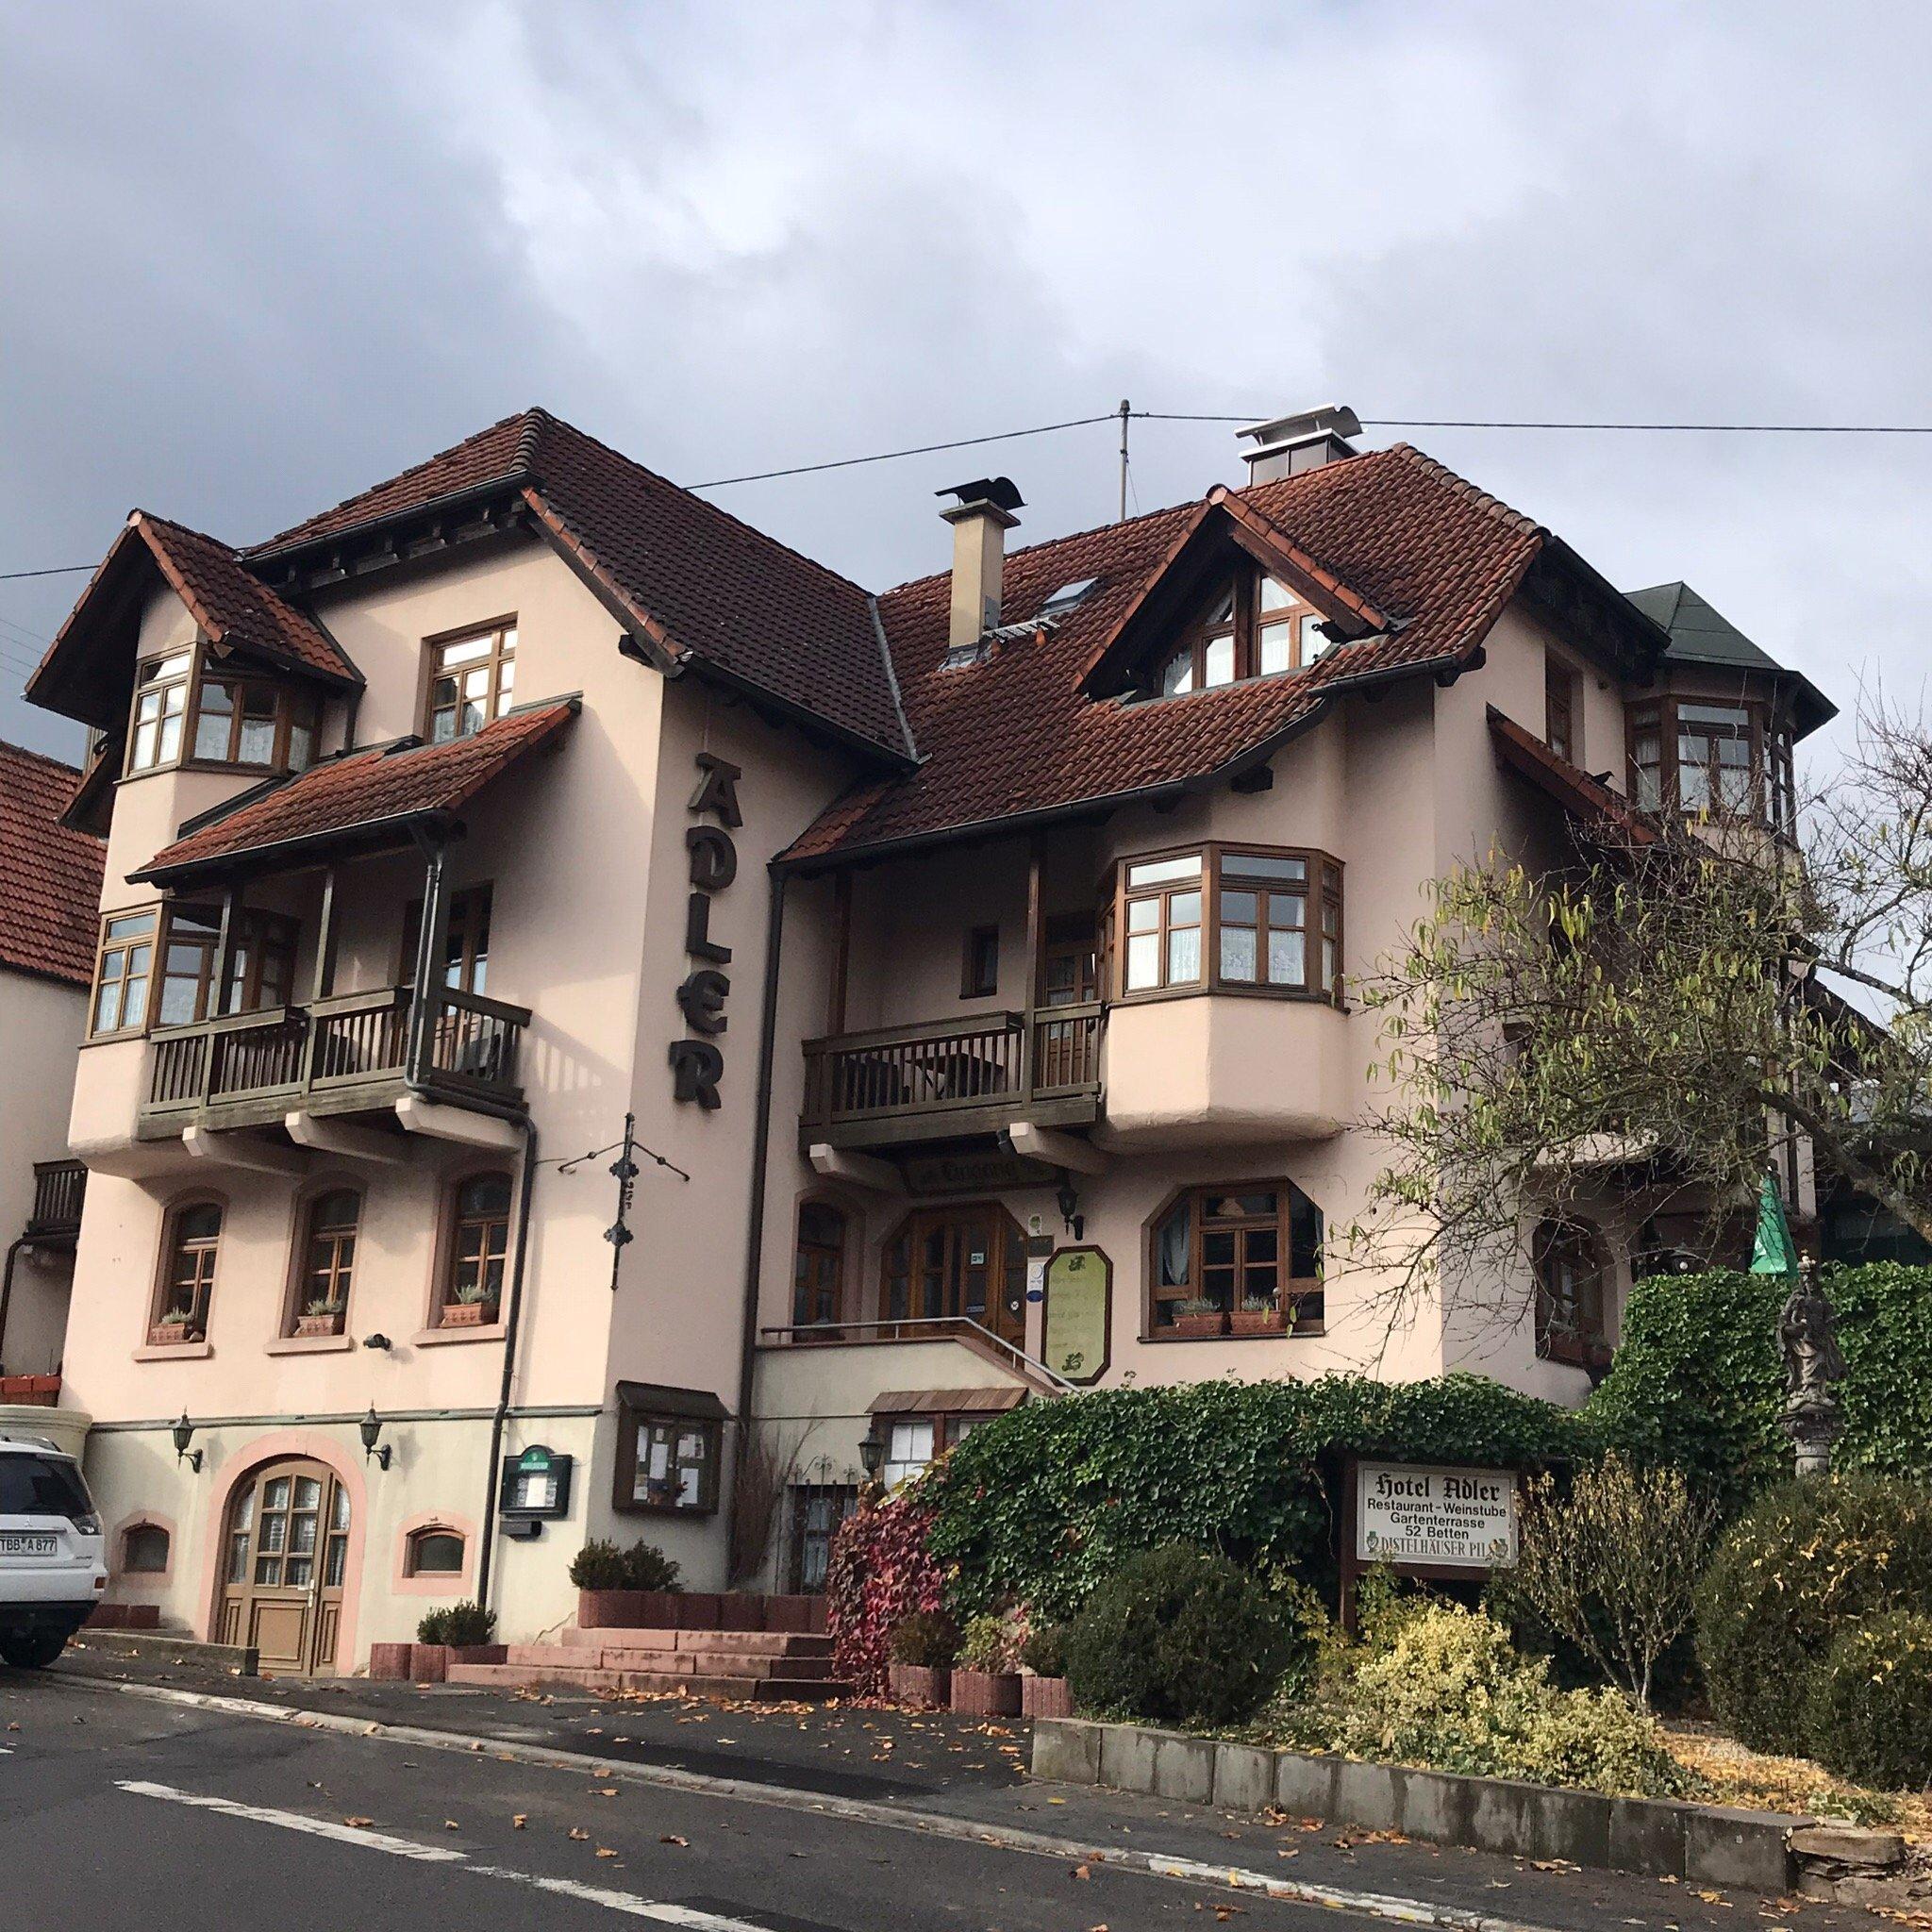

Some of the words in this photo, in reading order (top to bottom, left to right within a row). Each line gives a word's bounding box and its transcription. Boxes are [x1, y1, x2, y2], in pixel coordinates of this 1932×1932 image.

[669, 752, 743, 1110] ADLER
[1375, 1473, 1430, 1499] Hotel
[1443, 1476, 1500, 1502] Adler
[1391, 1512, 1485, 1529] Gartenterrasse
[1406, 1525, 1422, 1538] 52
[1427, 1527, 1469, 1541] Betten
[0, 1539, 20, 1551] TBB
[27, 1539, 34, 1551] A
[1381, 1537, 1465, 1557] DISTELHÄUSER
